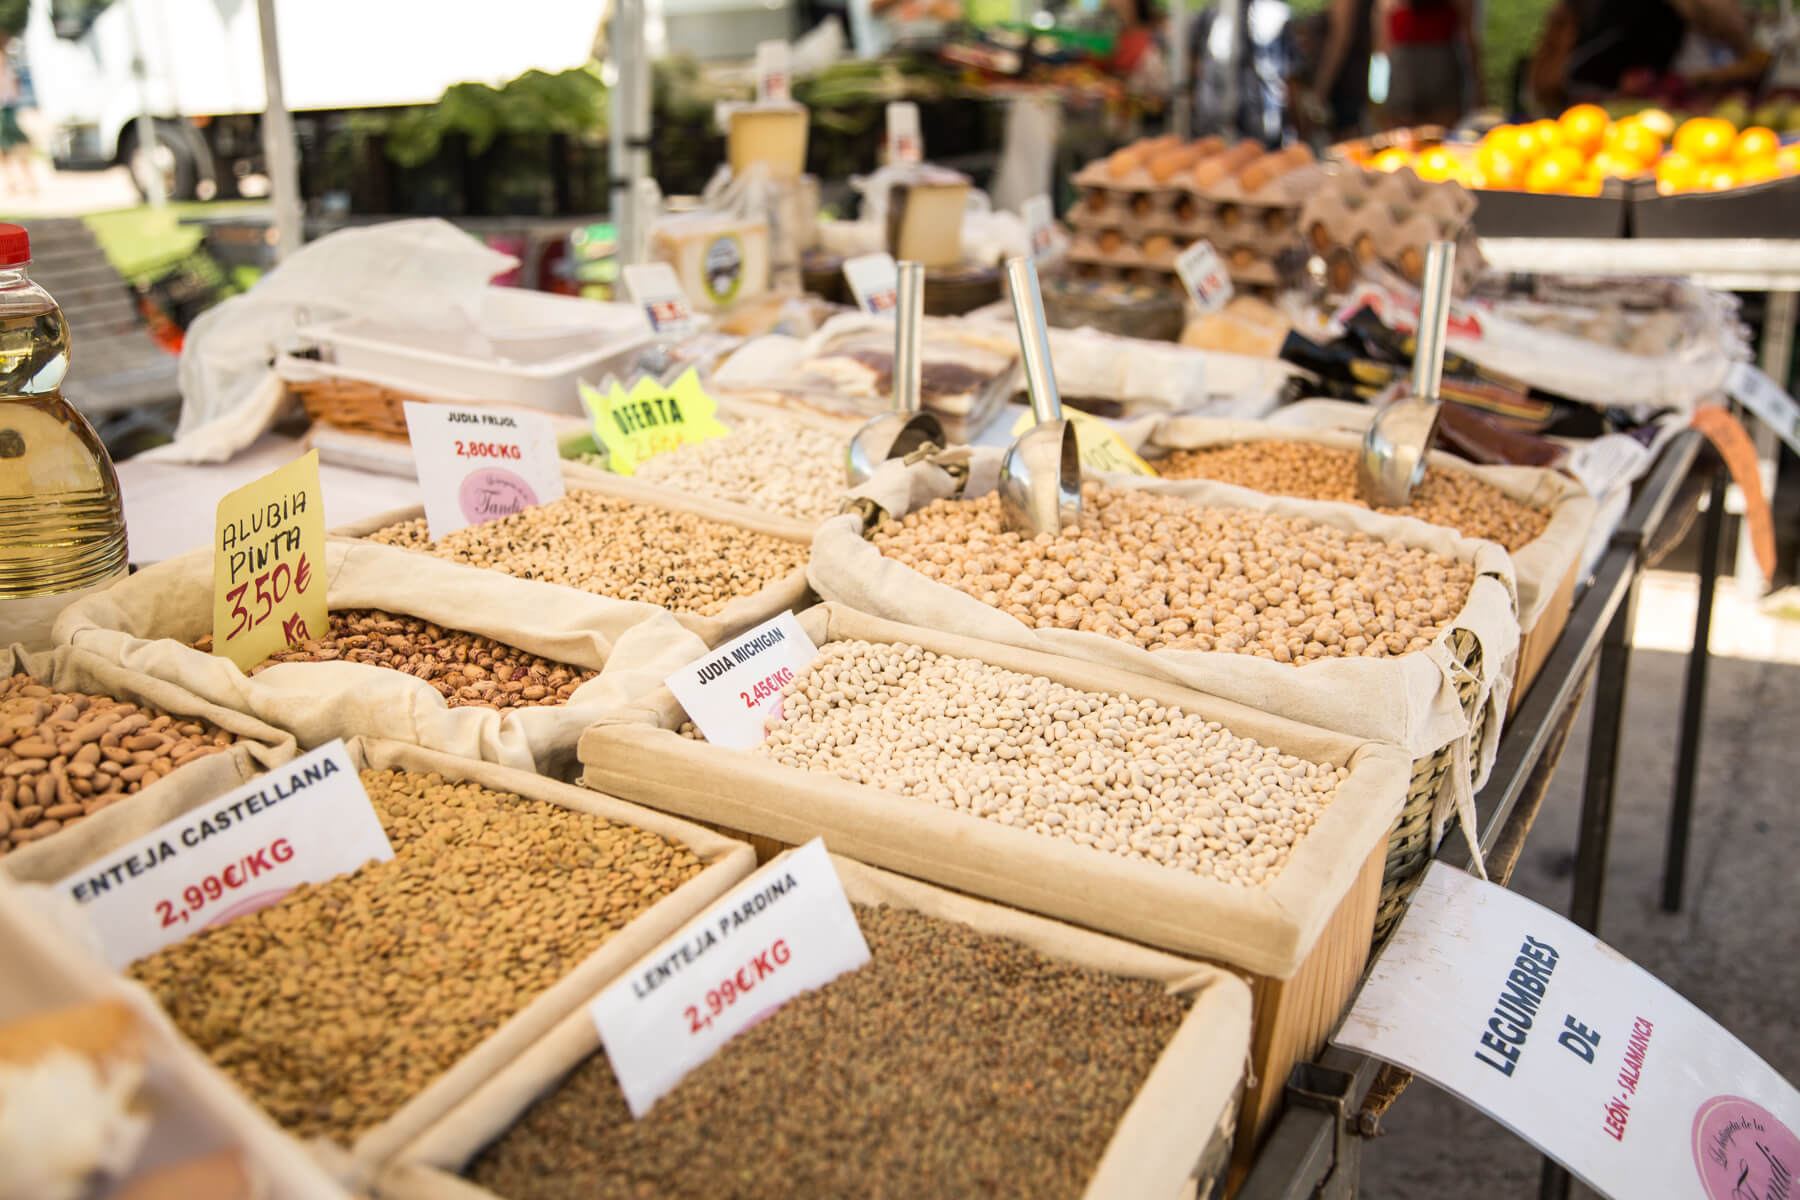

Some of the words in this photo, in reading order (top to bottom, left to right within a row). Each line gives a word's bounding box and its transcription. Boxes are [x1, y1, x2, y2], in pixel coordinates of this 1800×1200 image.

[448, 412, 479, 424] JUDIA
[481, 415, 518, 428] FRIJOL
[612, 397, 685, 436] OFERTA
[226, 552, 312, 641] 3,50€
[697, 655, 737, 686] JUDIA
[731, 626, 785, 664] MICHIGAN
[740, 666, 794, 709] 2,45€/KG
[71, 841, 177, 904] ENTEJA
[181, 756, 340, 848] CASTELLANA
[155, 837, 295, 928] 2,99€/KG
[632, 929, 717, 1000] LENTEJA
[718, 873, 798, 938] PARDINA
[684, 938, 791, 1036] 2,99€/KG
[1474, 935, 1560, 1078] LEGUMBRES
[1558, 1014, 1601, 1064] DE
[1602, 1096, 1632, 1142] LEÓN
[1617, 1015, 1655, 1096] SALAMANCA
